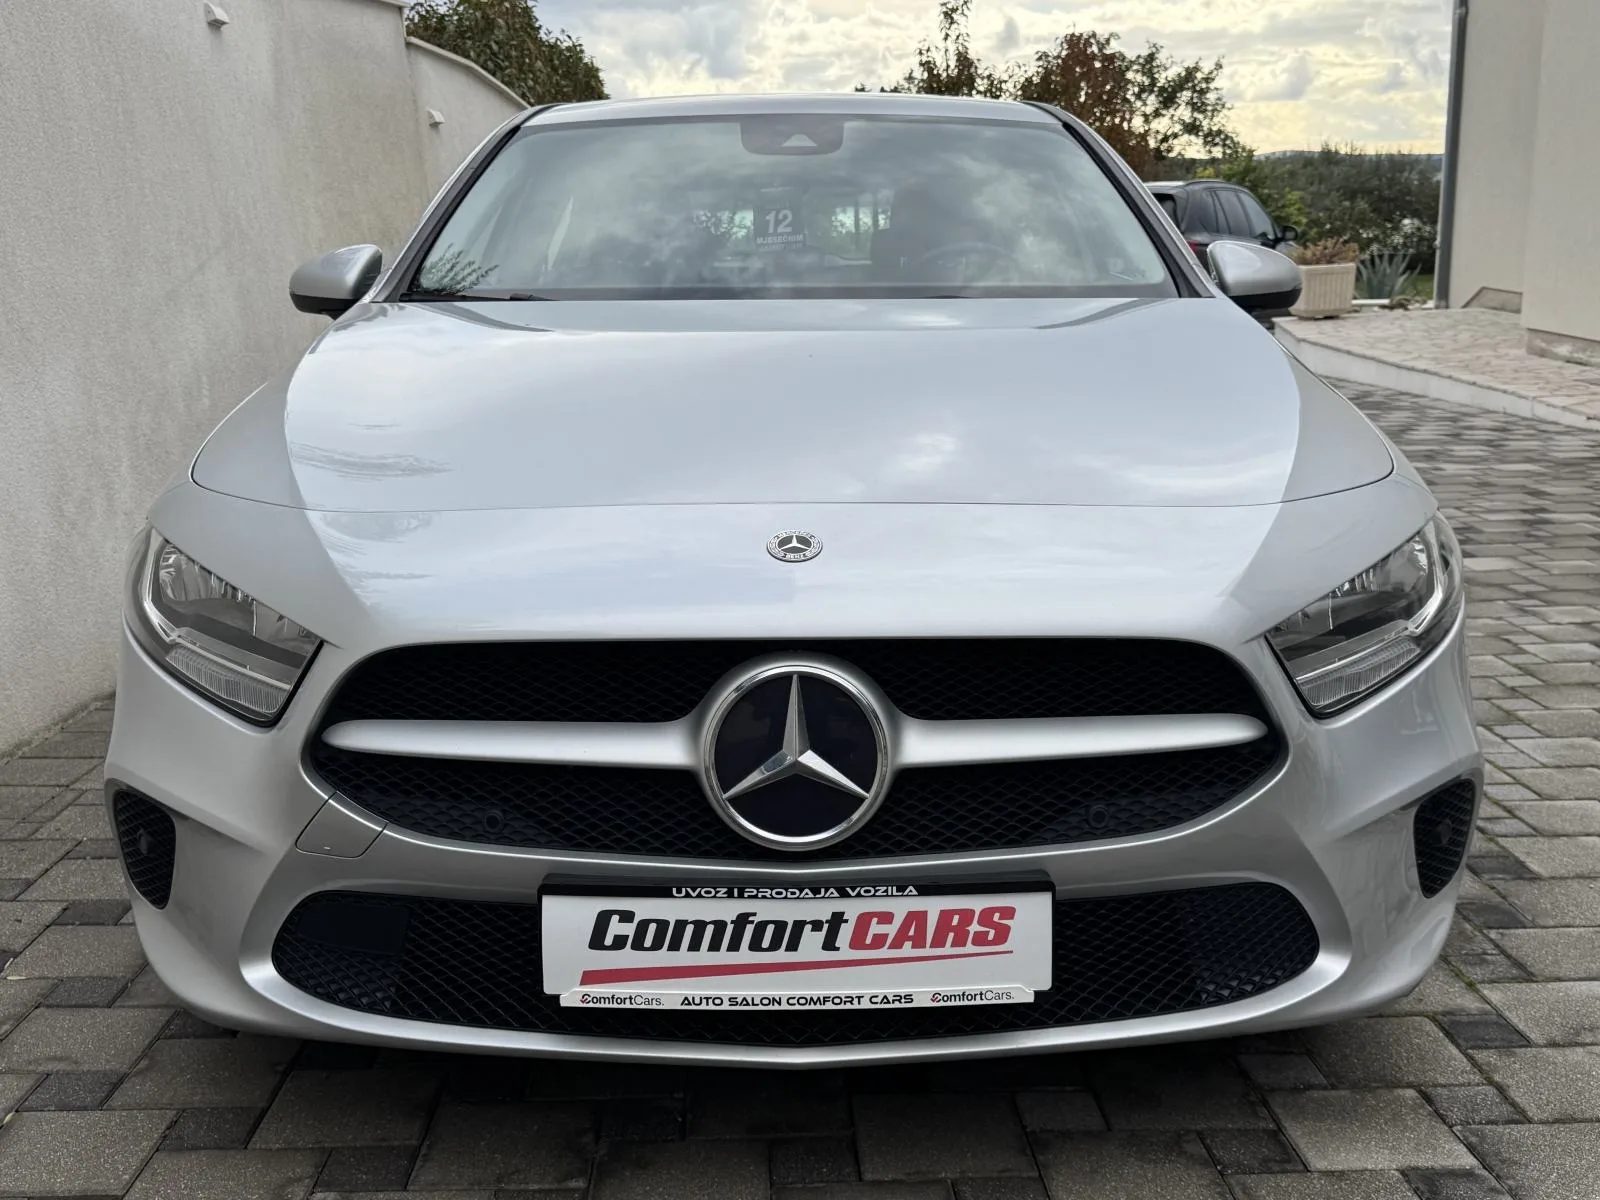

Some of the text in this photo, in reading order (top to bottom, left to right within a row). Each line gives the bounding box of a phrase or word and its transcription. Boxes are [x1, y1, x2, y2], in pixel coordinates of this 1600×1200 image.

[765, 209, 793, 234] 12
[672, 885, 919, 899] UVOZ I PRODAJA VOZILA
[587, 906, 1017, 952] ComfortCARS
[680, 994, 915, 1007] AUTO SALON COMFORT CARS
